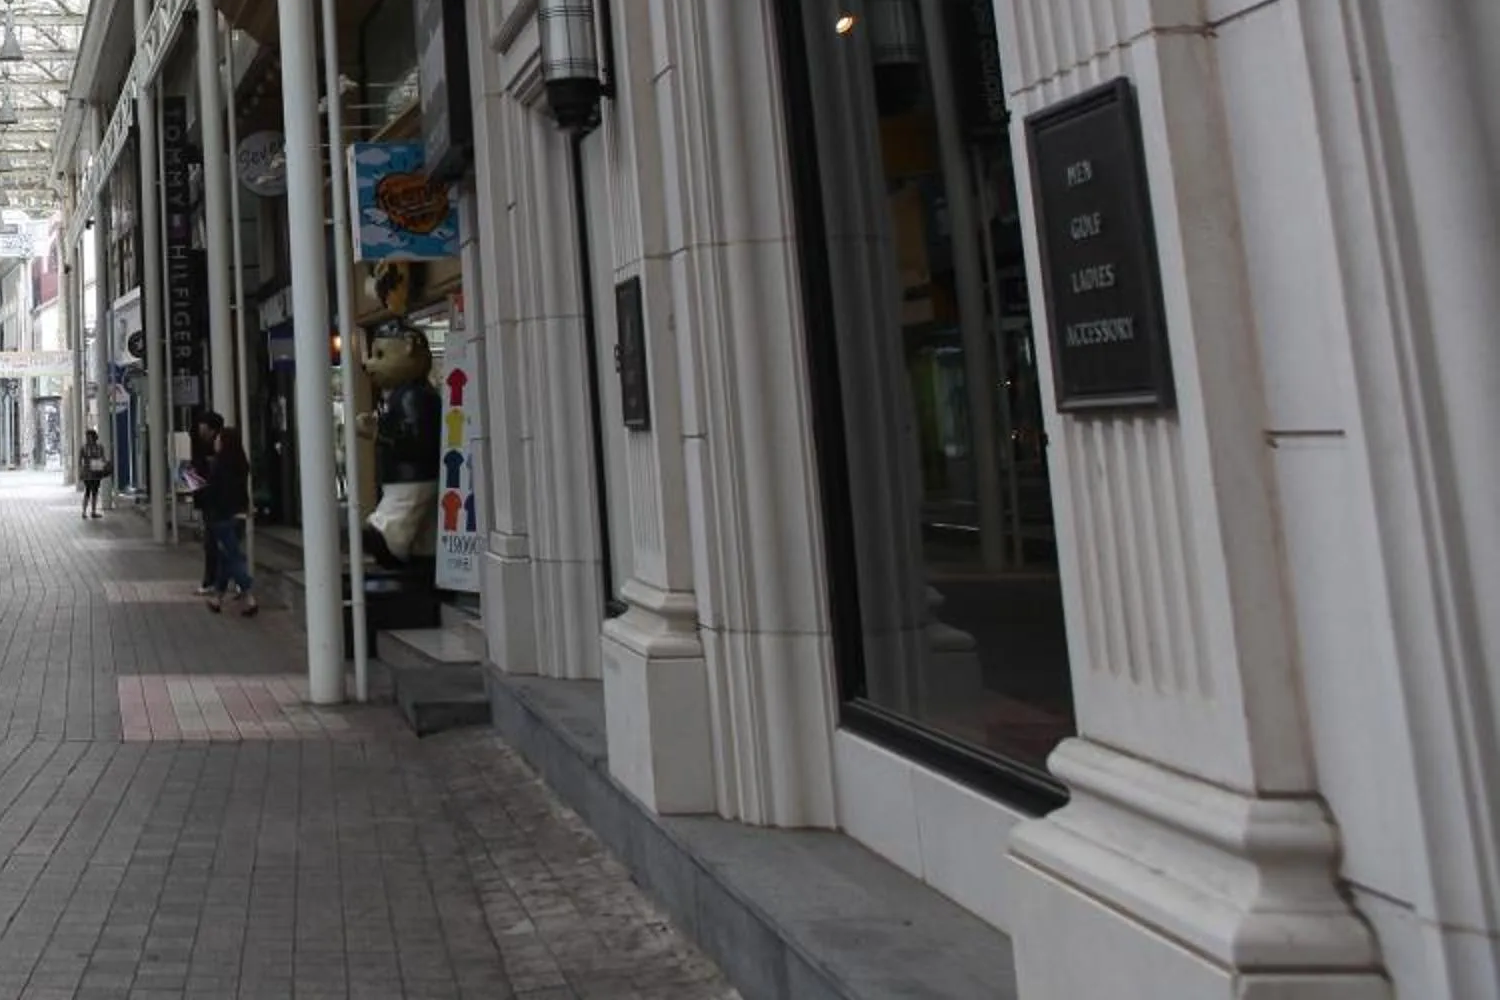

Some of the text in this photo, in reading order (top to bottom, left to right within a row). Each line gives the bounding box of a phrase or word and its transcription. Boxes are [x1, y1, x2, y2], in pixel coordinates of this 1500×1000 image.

[166, 108, 190, 209] TOMMY
[1067, 159, 1093, 187] MEN
[1069, 211, 1102, 241] GOLF
[1071, 264, 1115, 294] LADIES
[169, 245, 192, 360] HILFIGER
[1066, 316, 1135, 347] ACCESSORY
